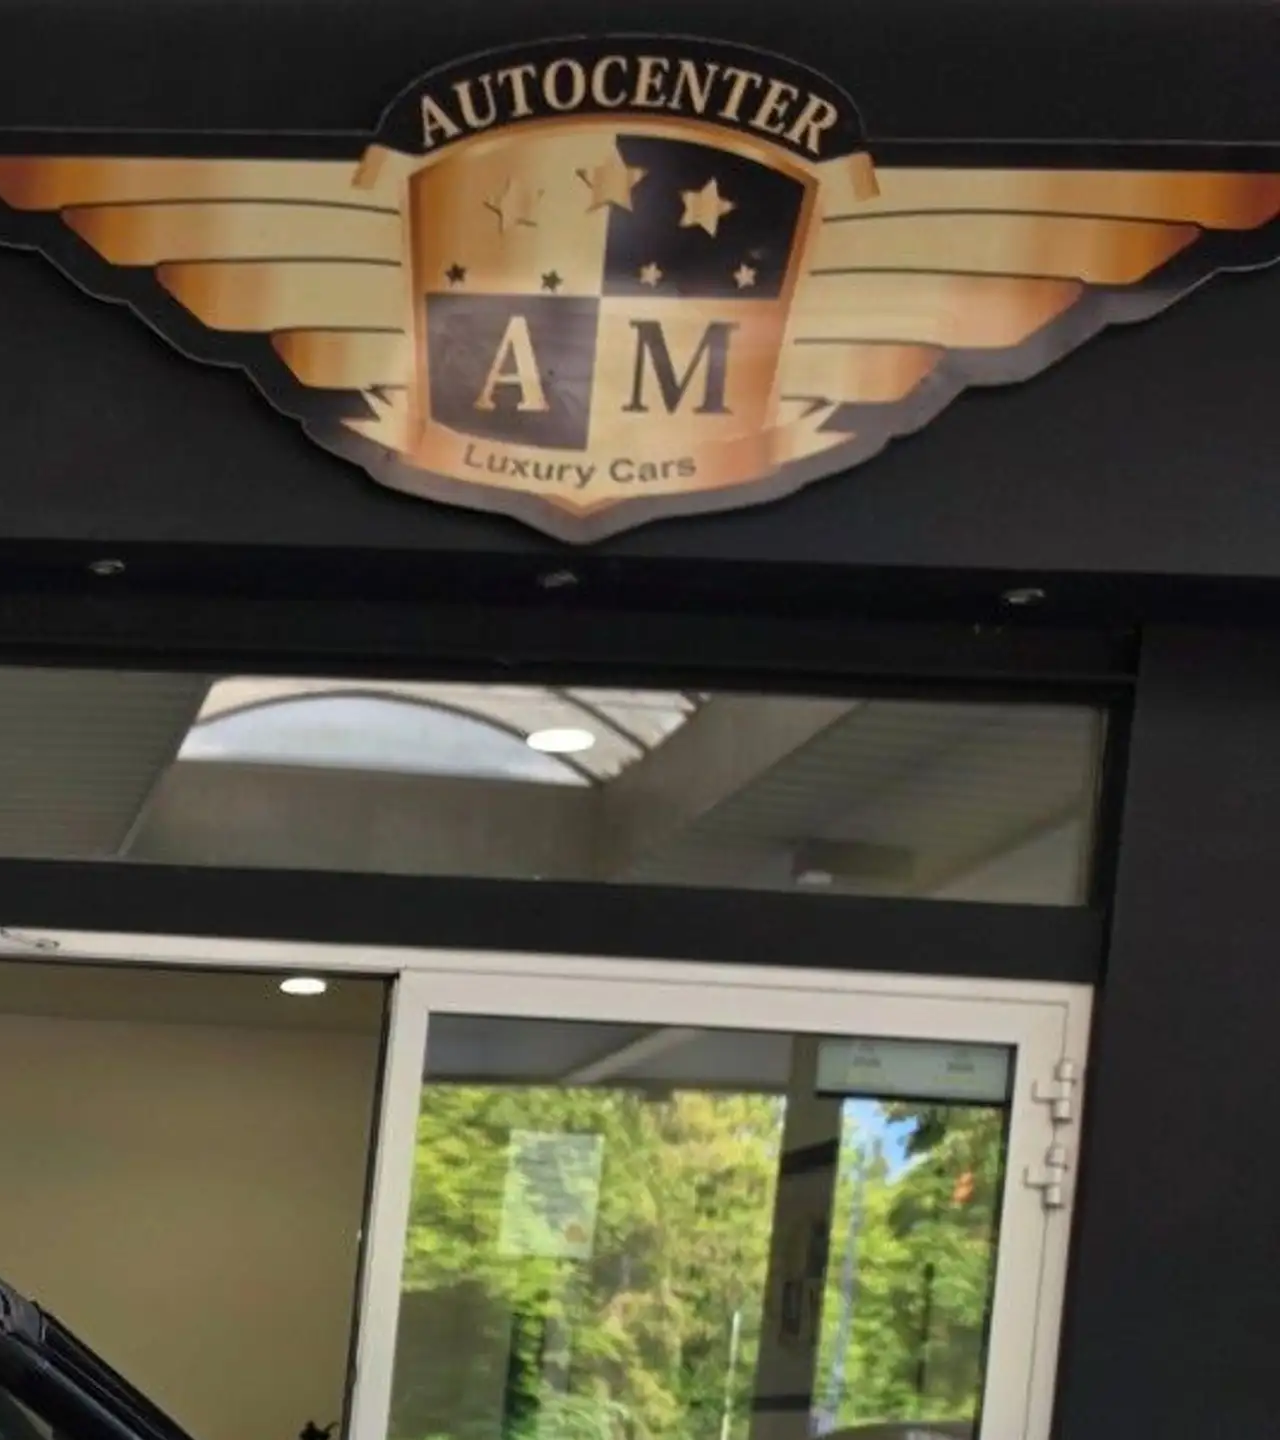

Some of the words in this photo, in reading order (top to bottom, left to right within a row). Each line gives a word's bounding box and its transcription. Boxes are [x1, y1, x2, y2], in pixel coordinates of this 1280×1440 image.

[417, 54, 839, 156] AUTOCENTER
[474, 314, 550, 412] A
[621, 318, 739, 416] M
[463, 443, 595, 489] Luxury
[609, 452, 697, 483] Cars
